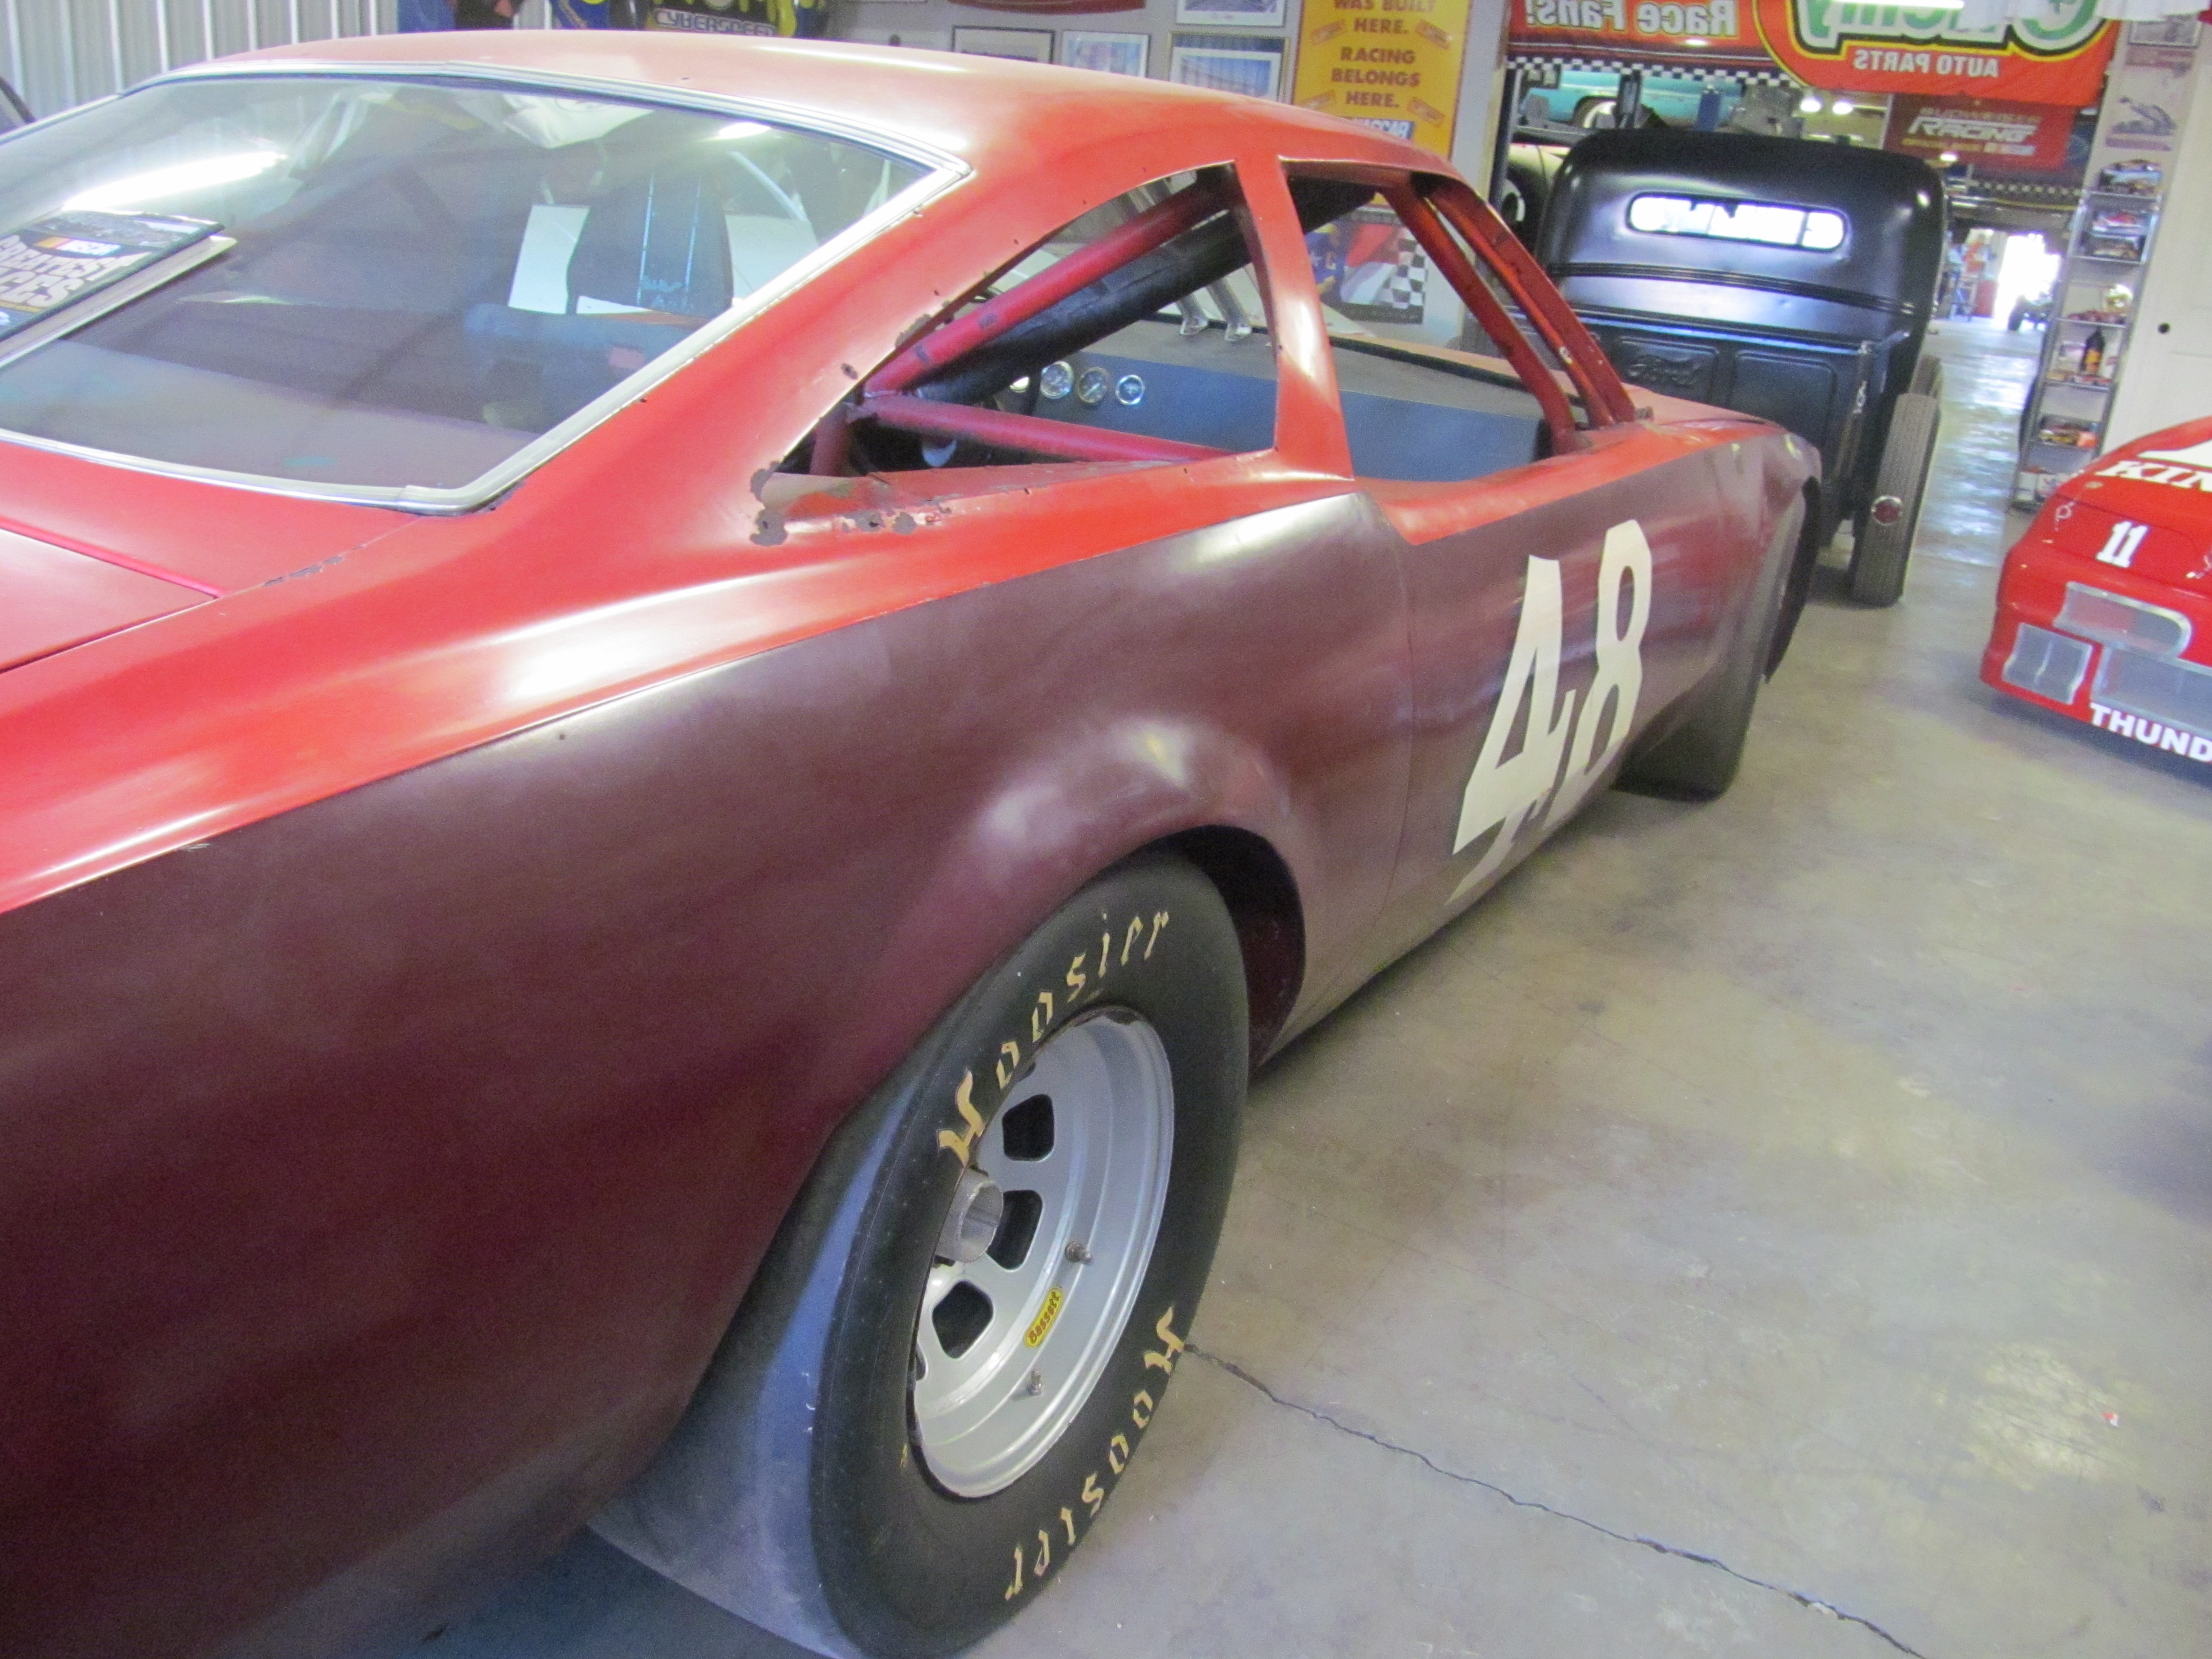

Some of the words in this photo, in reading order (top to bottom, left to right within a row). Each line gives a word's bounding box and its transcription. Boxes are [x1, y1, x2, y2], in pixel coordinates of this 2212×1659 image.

[1354, 17, 1409, 34] HERE.
[1340, 46, 1416, 65] RACING
[1331, 68, 1421, 88] BELONGS
[1345, 91, 1400, 108] HERE.
[2095, 521, 2149, 568] 11
[1445, 519, 1653, 907] 48
[2089, 701, 2212, 762] THUND
[1028, 1291, 1060, 1344] Bassett
